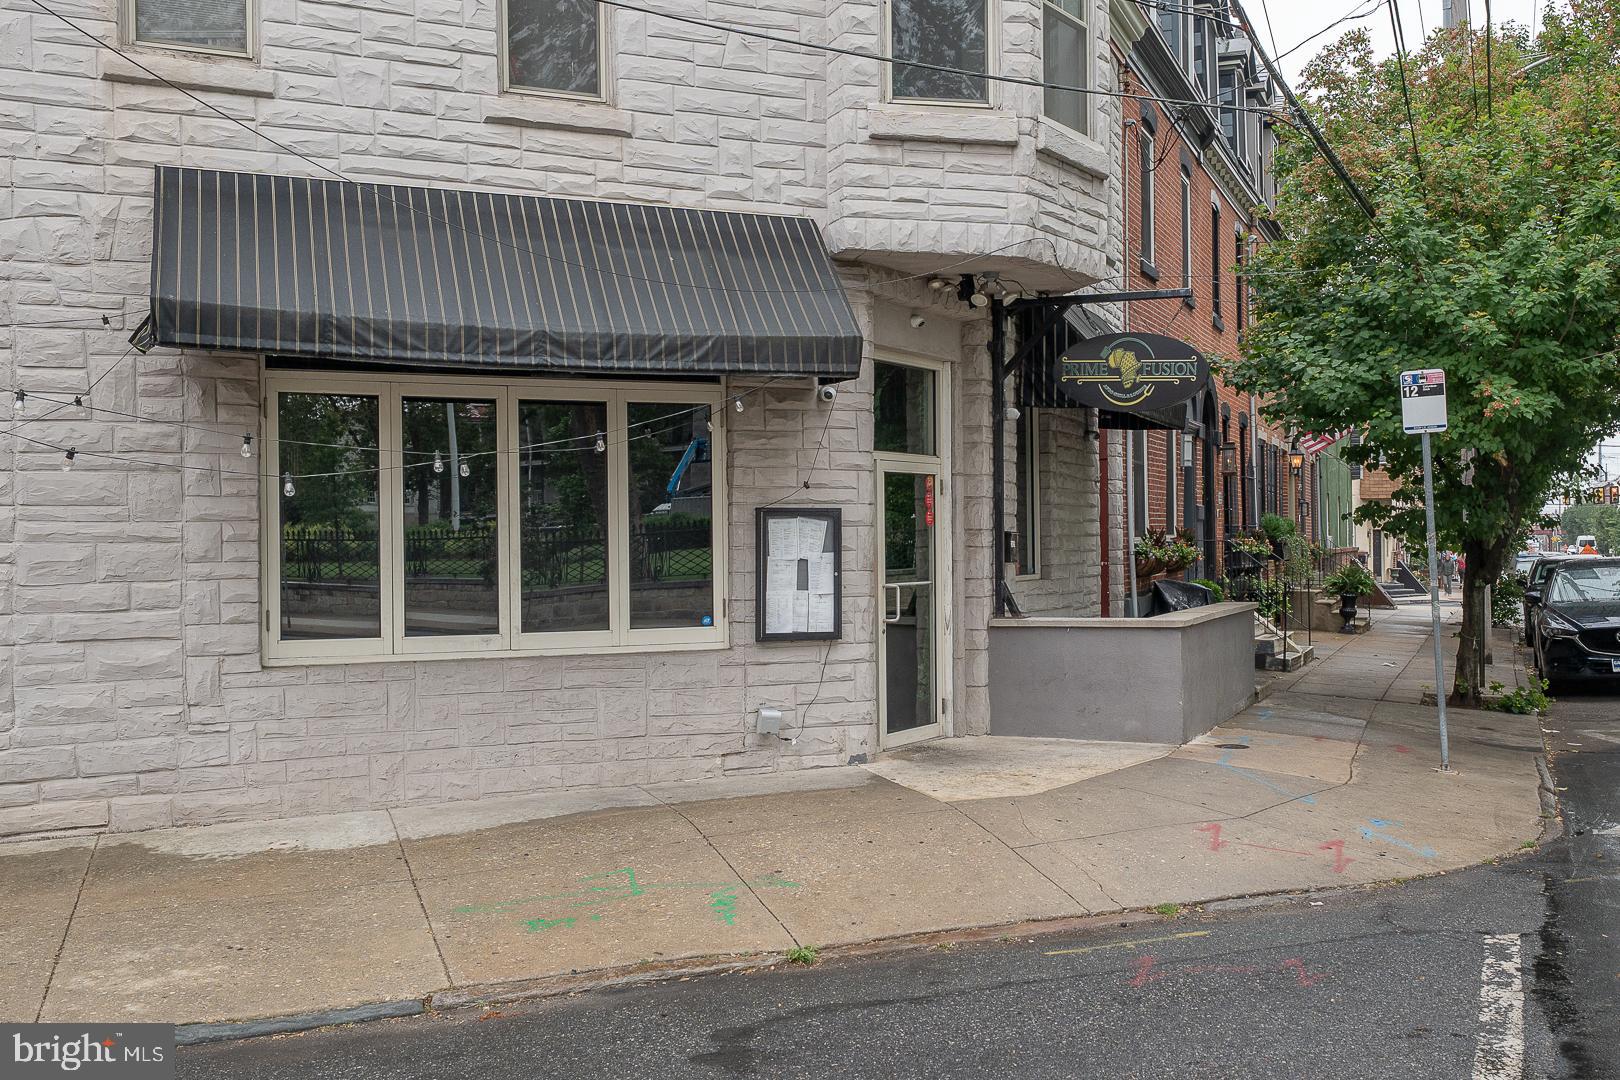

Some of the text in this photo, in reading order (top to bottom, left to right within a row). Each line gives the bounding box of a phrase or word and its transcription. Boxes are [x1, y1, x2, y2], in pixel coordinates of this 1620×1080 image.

[1062, 362, 1198, 376] PRIME FUSION
[1404, 386, 1418, 397] 12
